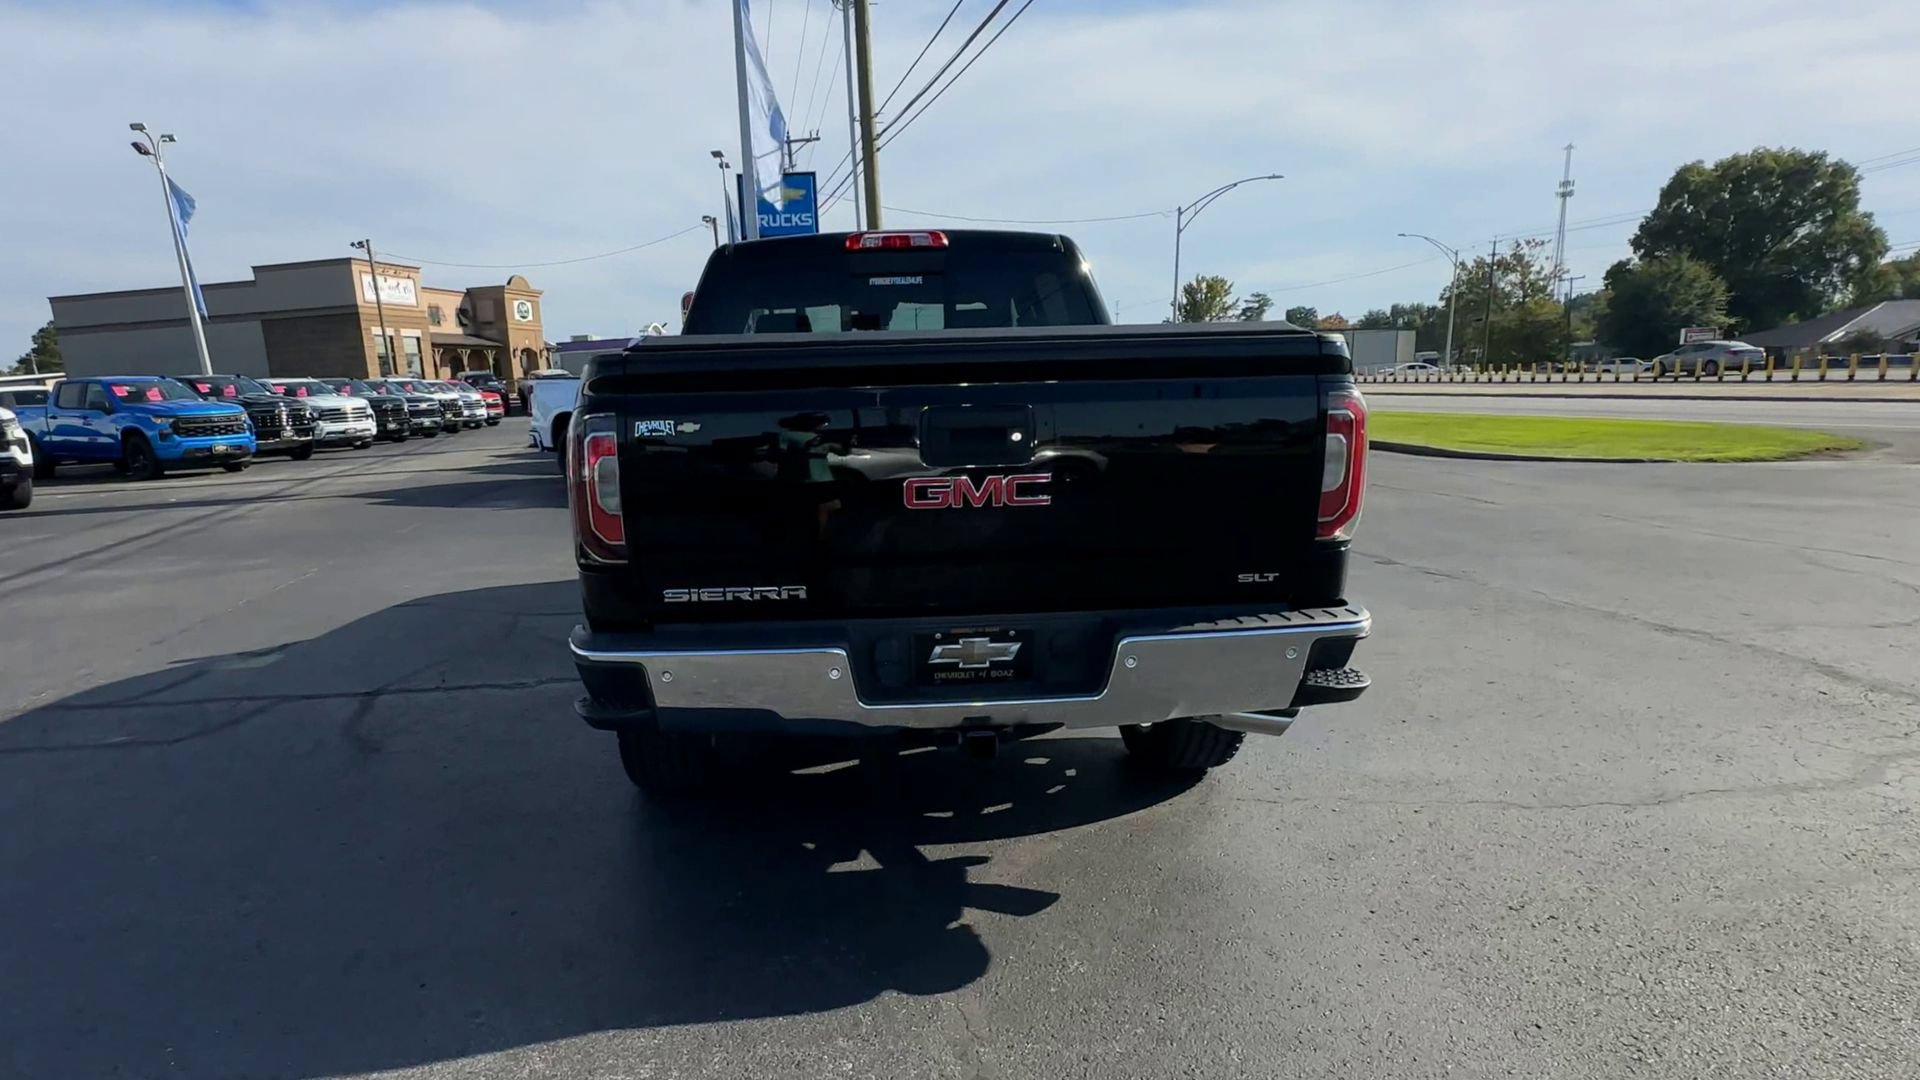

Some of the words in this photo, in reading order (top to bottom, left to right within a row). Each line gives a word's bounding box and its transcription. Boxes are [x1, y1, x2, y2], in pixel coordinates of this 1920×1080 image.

[758, 213, 813, 227] RUCKS
[904, 473, 1052, 509] GMC
[1238, 573, 1280, 582] SLT
[663, 586, 807, 602] SIERRA
